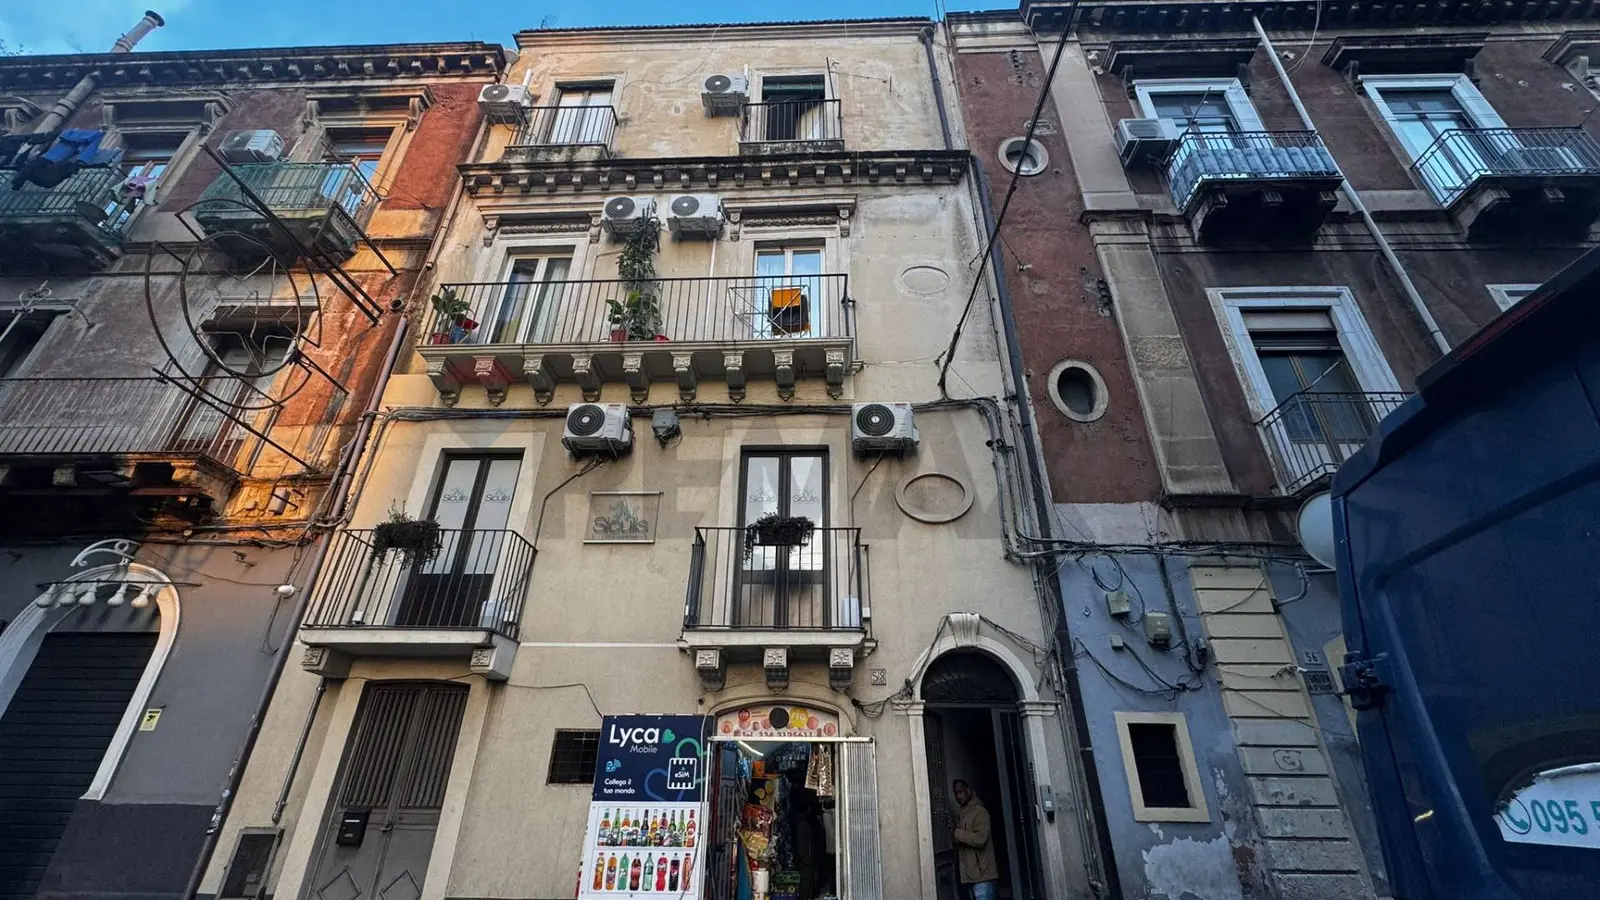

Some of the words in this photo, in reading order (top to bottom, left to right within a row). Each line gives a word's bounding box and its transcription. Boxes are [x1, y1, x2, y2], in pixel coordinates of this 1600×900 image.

[1305, 652, 1319, 662] 56
[872, 671, 885, 683] 58
[609, 723, 660, 747] Lyca
[629, 745, 658, 753] Mobile
[604, 778, 627, 787] Collega
[1530, 799, 1588, 835] 095
